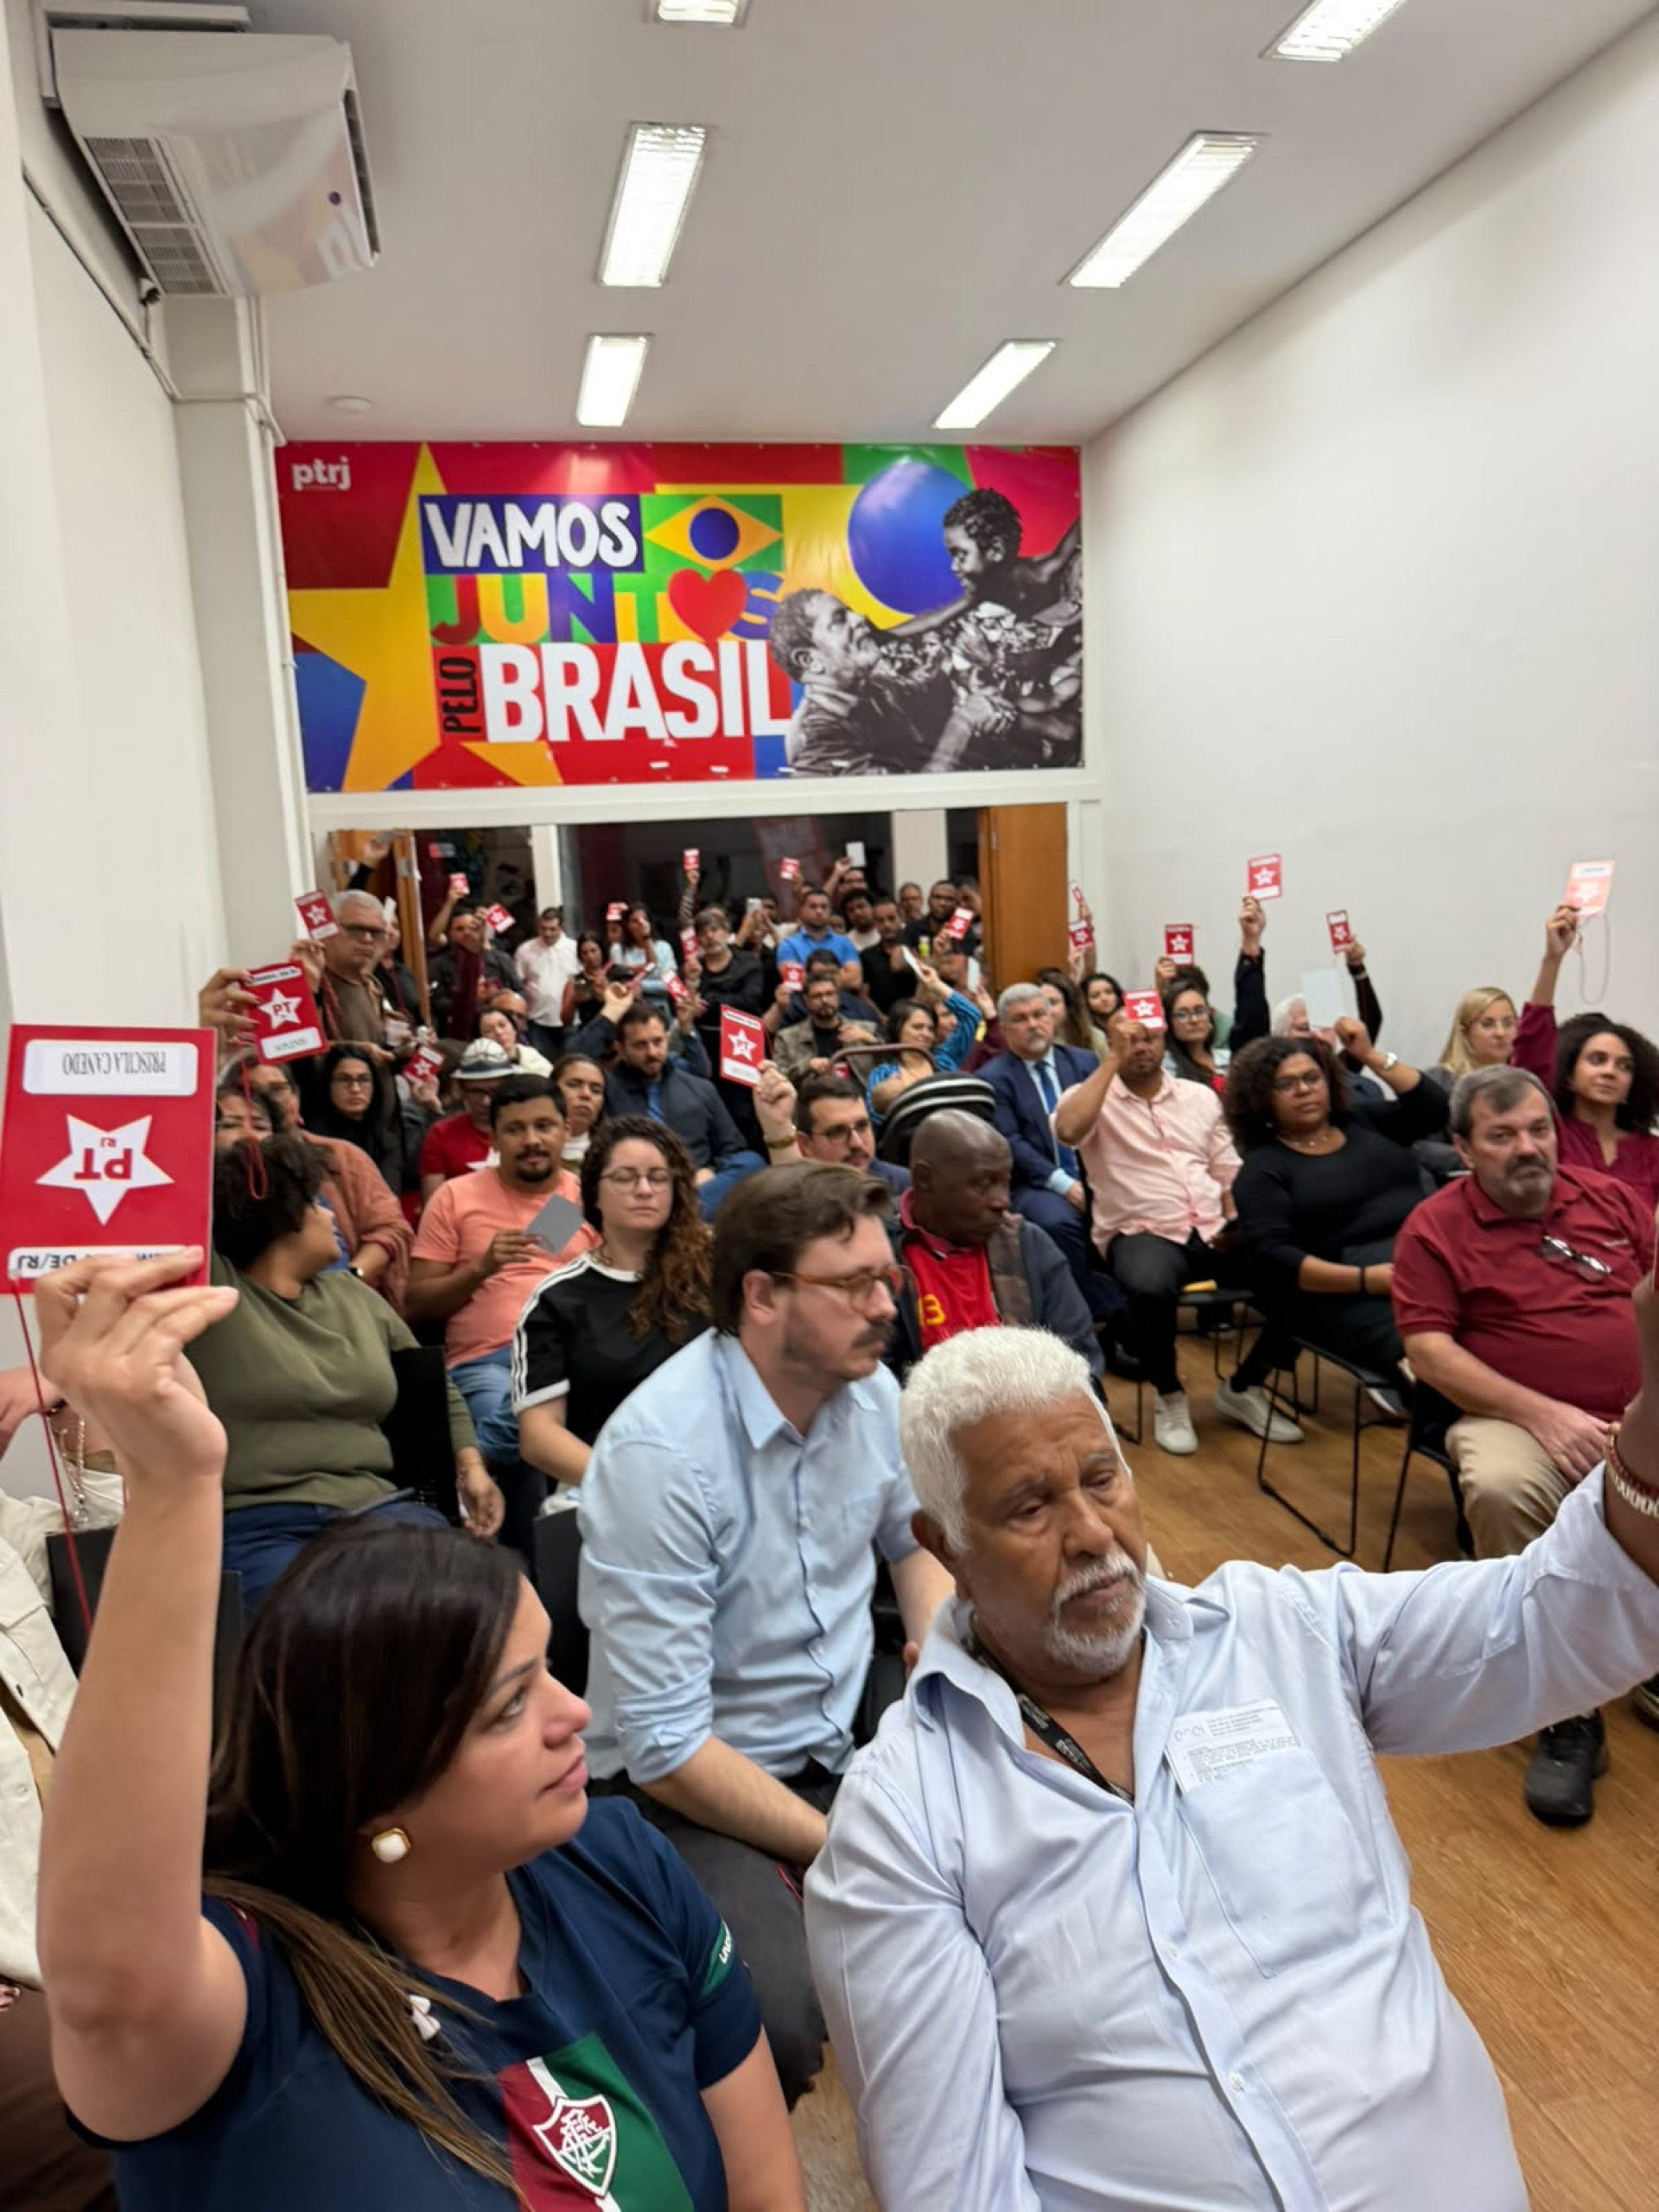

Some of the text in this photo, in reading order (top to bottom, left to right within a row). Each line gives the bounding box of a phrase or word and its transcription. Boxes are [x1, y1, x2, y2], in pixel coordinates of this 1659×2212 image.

[292, 455, 351, 491] ptrj
[423, 501, 639, 568] VAMOS
[430, 568, 784, 645] JUNTS
[439, 657, 480, 734] PELO
[479, 640, 792, 742] BRASIL
[272, 1002, 291, 1017] PT
[62, 1051, 167, 1076] PRISCILA CANEDO
[100, 1137, 118, 1147] RJ
[73, 1147, 133, 1180] PT
